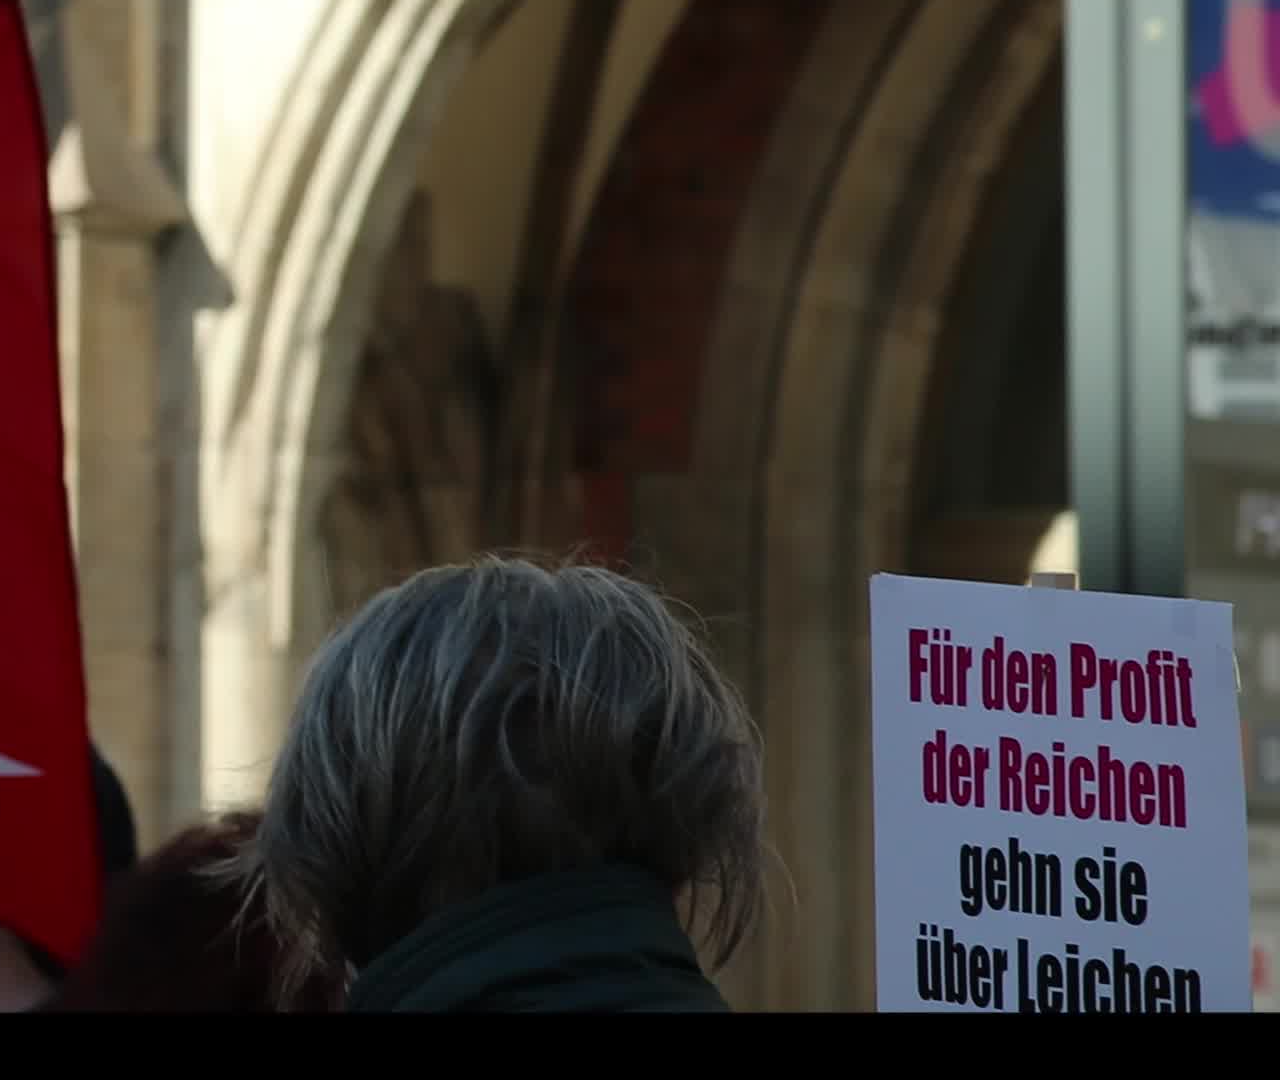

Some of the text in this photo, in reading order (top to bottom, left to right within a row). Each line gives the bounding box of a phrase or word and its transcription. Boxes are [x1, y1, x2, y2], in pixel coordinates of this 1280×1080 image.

[908, 627, 1197, 729] Für den Profit
[922, 729, 1187, 829] der Reichen
[959, 836, 1148, 926] gehn sie
[915, 922, 1202, 1013] über Leichen
